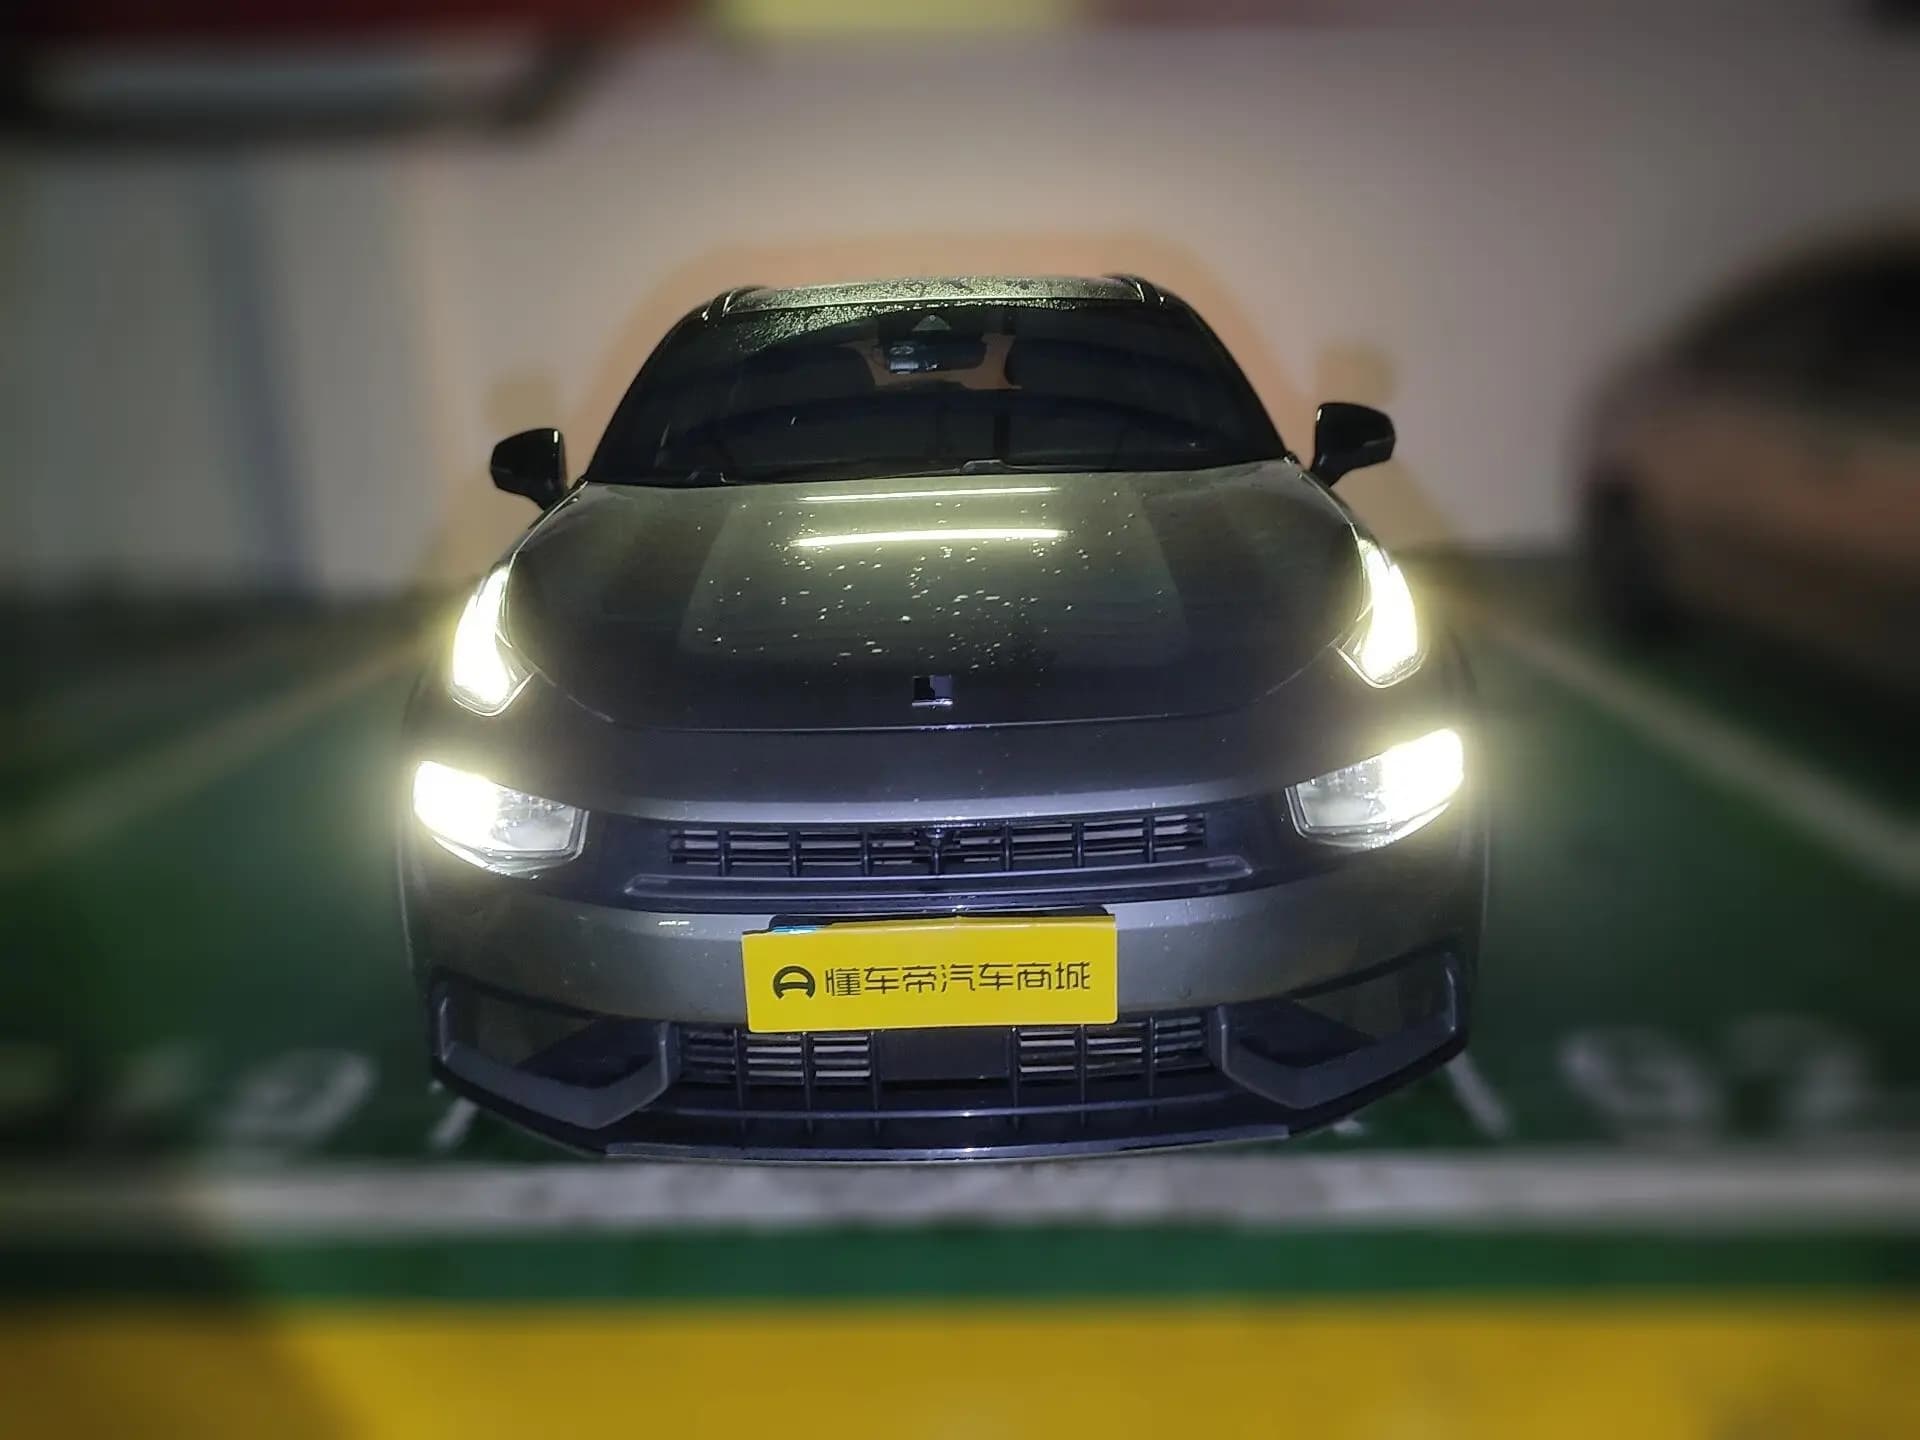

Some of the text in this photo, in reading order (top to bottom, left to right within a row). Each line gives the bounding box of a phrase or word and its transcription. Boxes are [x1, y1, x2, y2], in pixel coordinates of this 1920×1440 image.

[824, 960, 1091, 997] 懂车帝汽车商城
